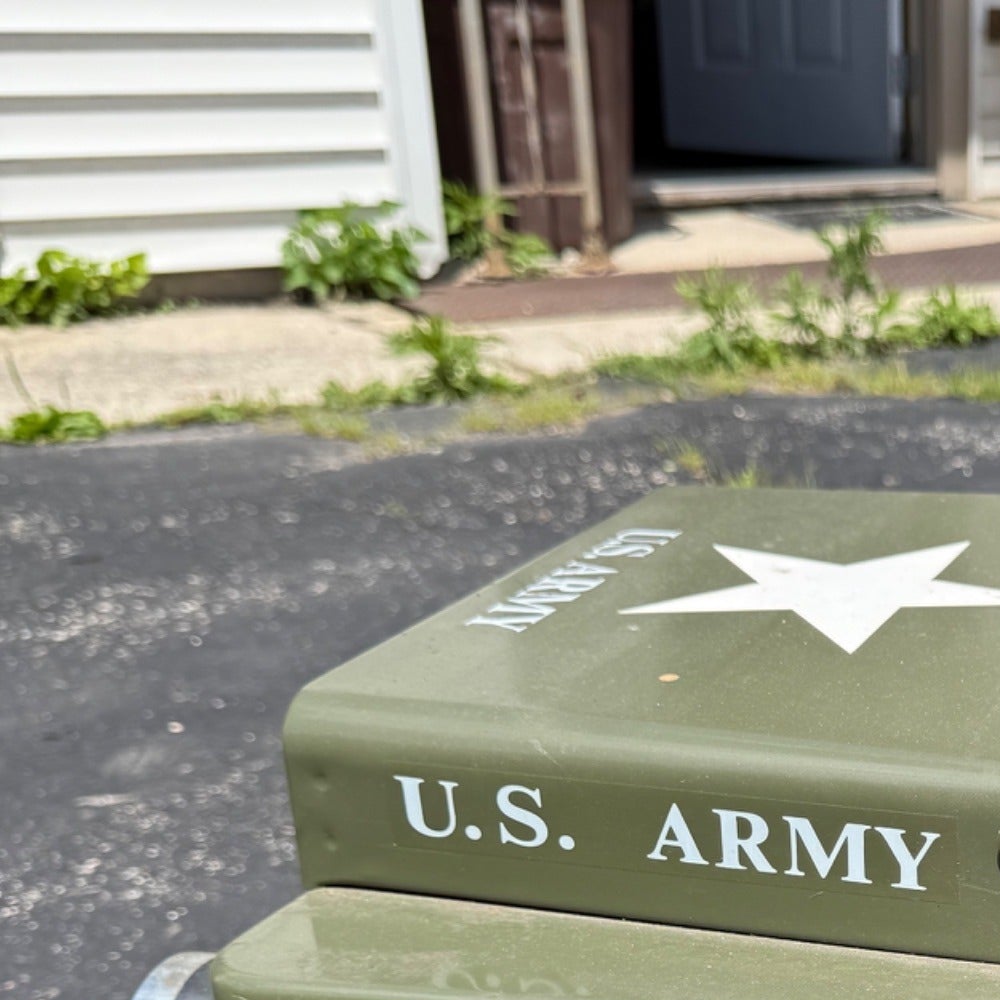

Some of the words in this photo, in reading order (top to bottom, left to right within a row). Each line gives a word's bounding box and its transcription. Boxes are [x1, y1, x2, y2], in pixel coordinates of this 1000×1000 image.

[464, 560, 619, 633] ARMY
[393, 775, 576, 851] U.S.
[646, 803, 941, 891] ARMY
